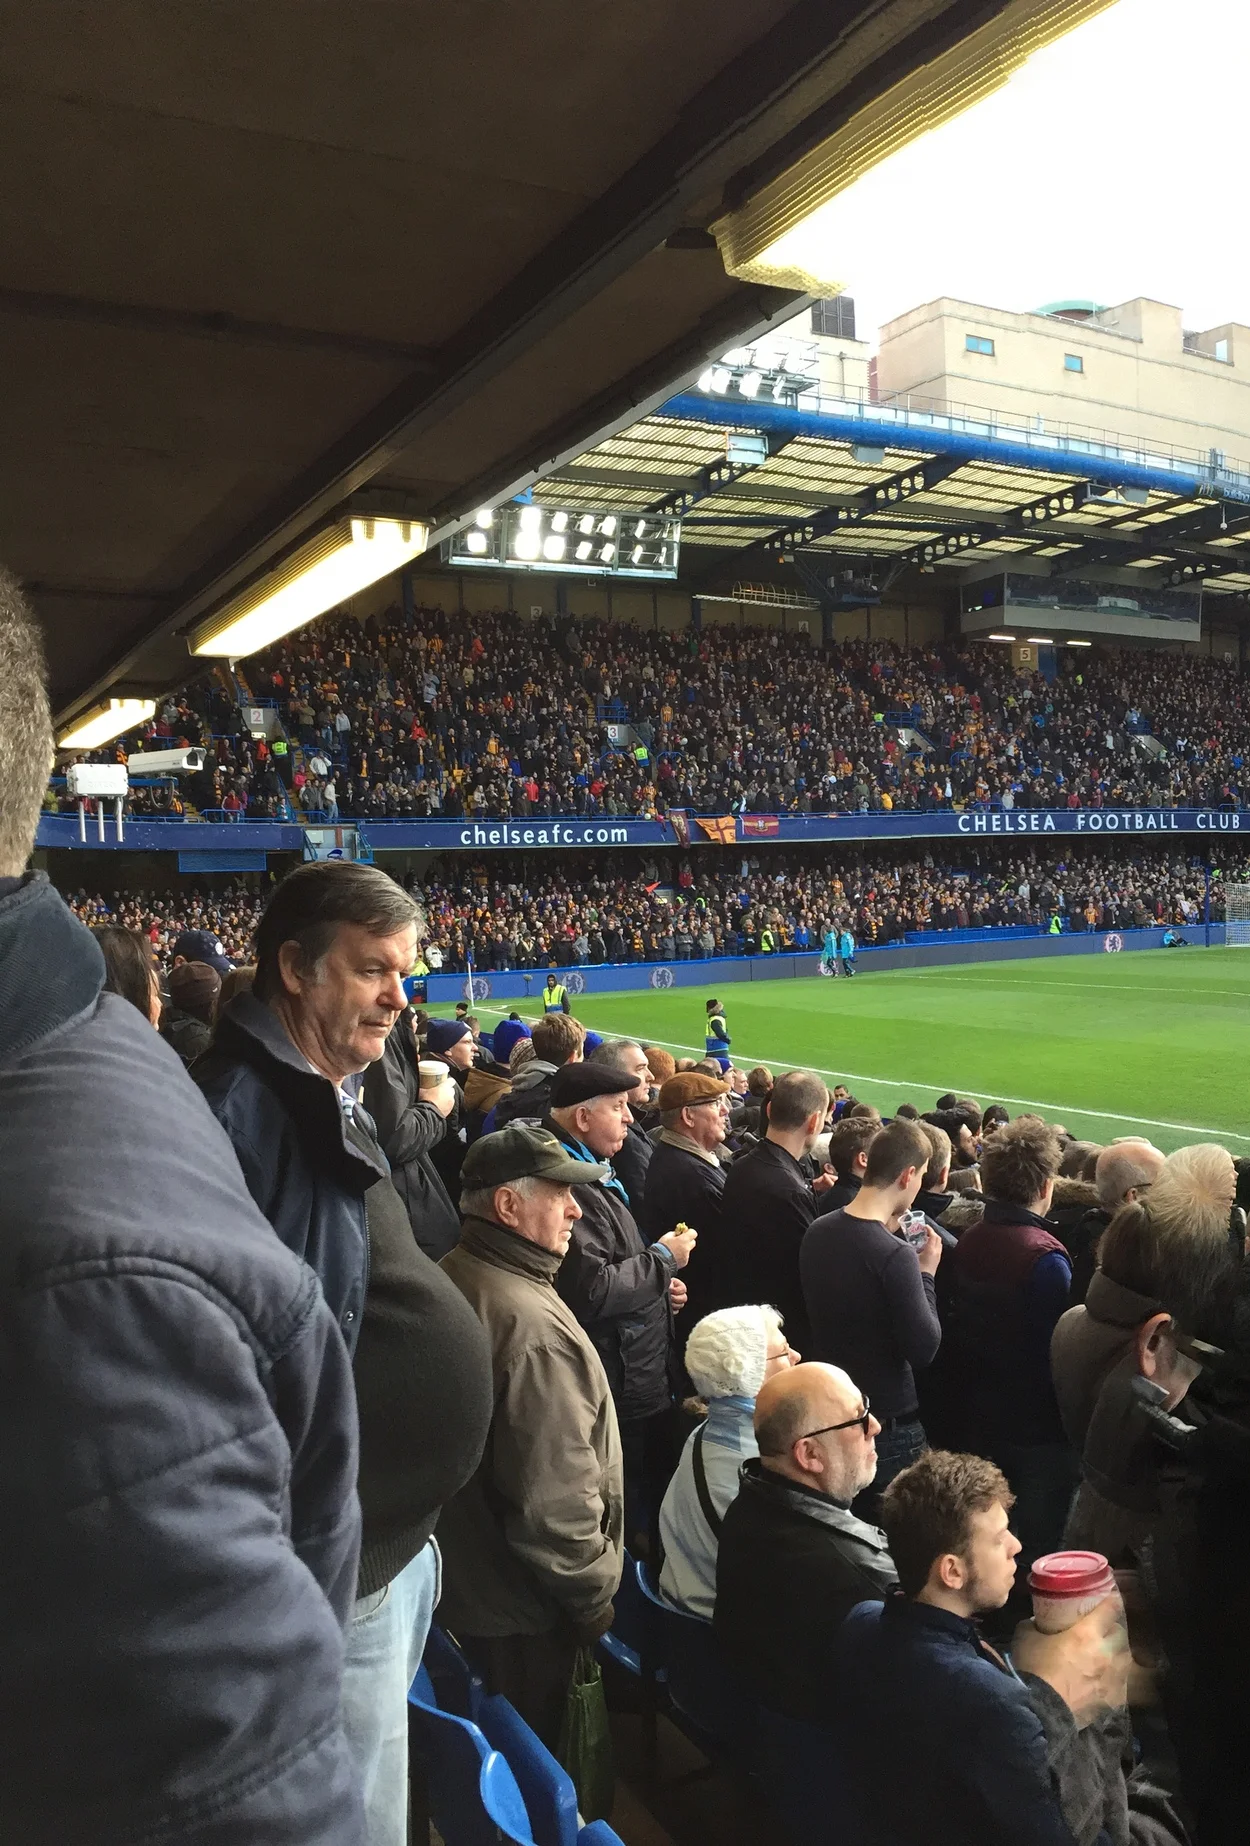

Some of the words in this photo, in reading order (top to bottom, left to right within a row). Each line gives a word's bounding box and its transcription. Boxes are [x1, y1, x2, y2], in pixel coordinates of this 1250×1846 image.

[1022, 649, 1029, 660] 5
[252, 710, 262, 722] 2
[610, 727, 617, 738] 3
[958, 814, 1056, 832] CHELSEA
[1077, 813, 1178, 830] FOOTBALL
[1196, 813, 1240, 829] CLUB
[460, 823, 628, 845] chelseafc.com
